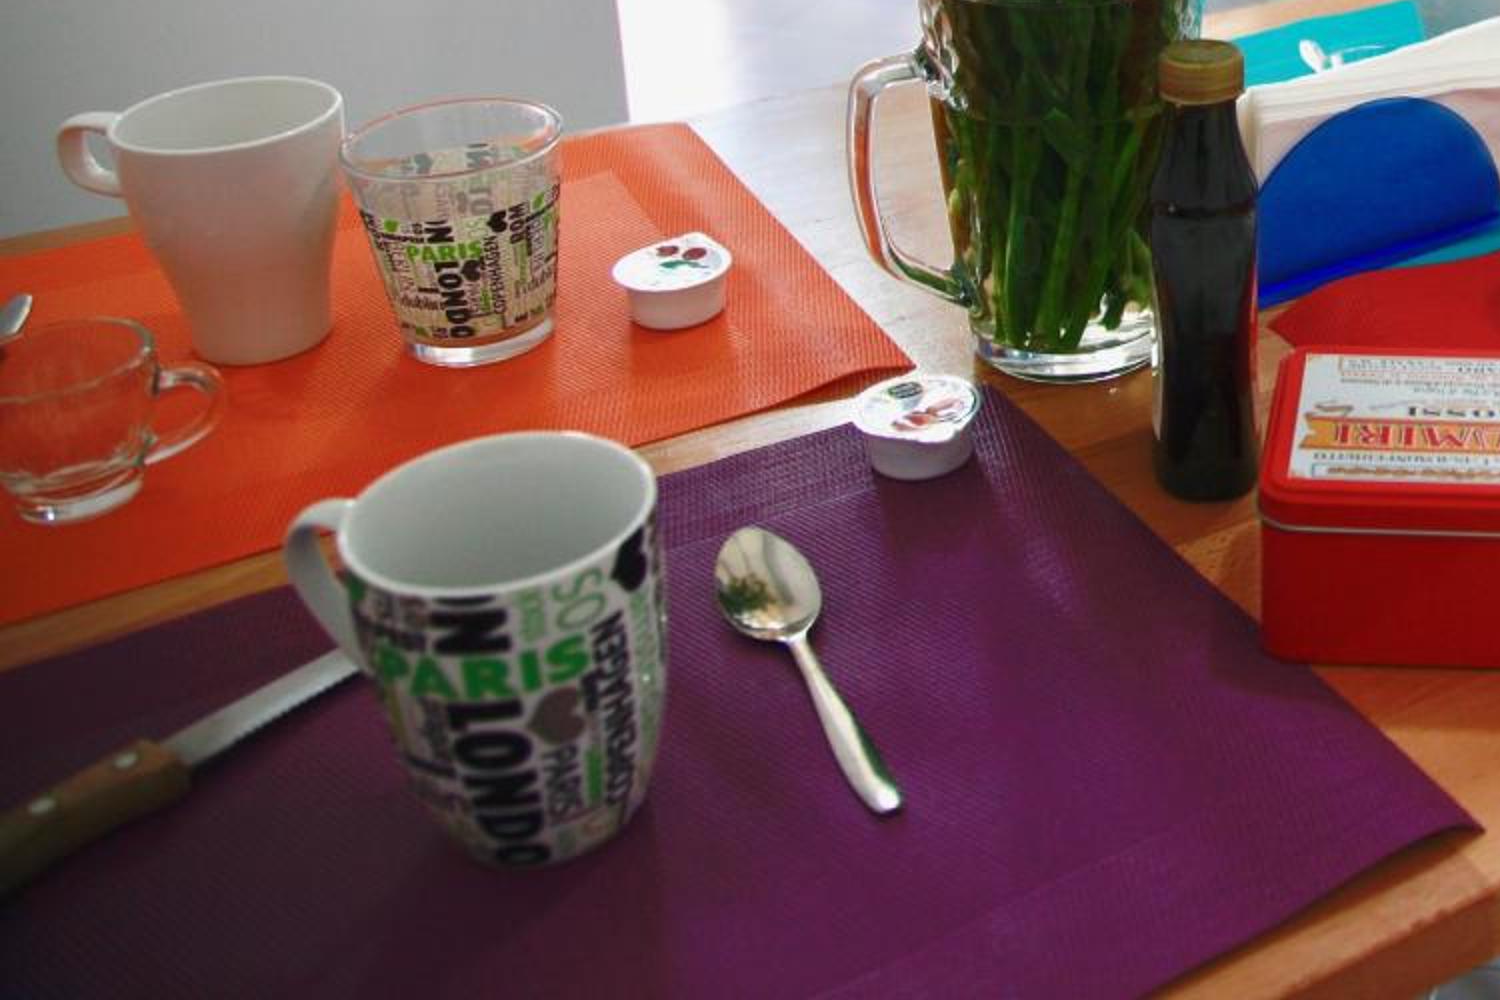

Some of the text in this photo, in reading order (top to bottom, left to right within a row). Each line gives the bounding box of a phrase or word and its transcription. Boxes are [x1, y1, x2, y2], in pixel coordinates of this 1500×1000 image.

[408, 241, 482, 264] PARIS
[434, 260, 475, 340] LONDO
[373, 634, 590, 701] PARIS
[446, 699, 552, 866] LONDO
